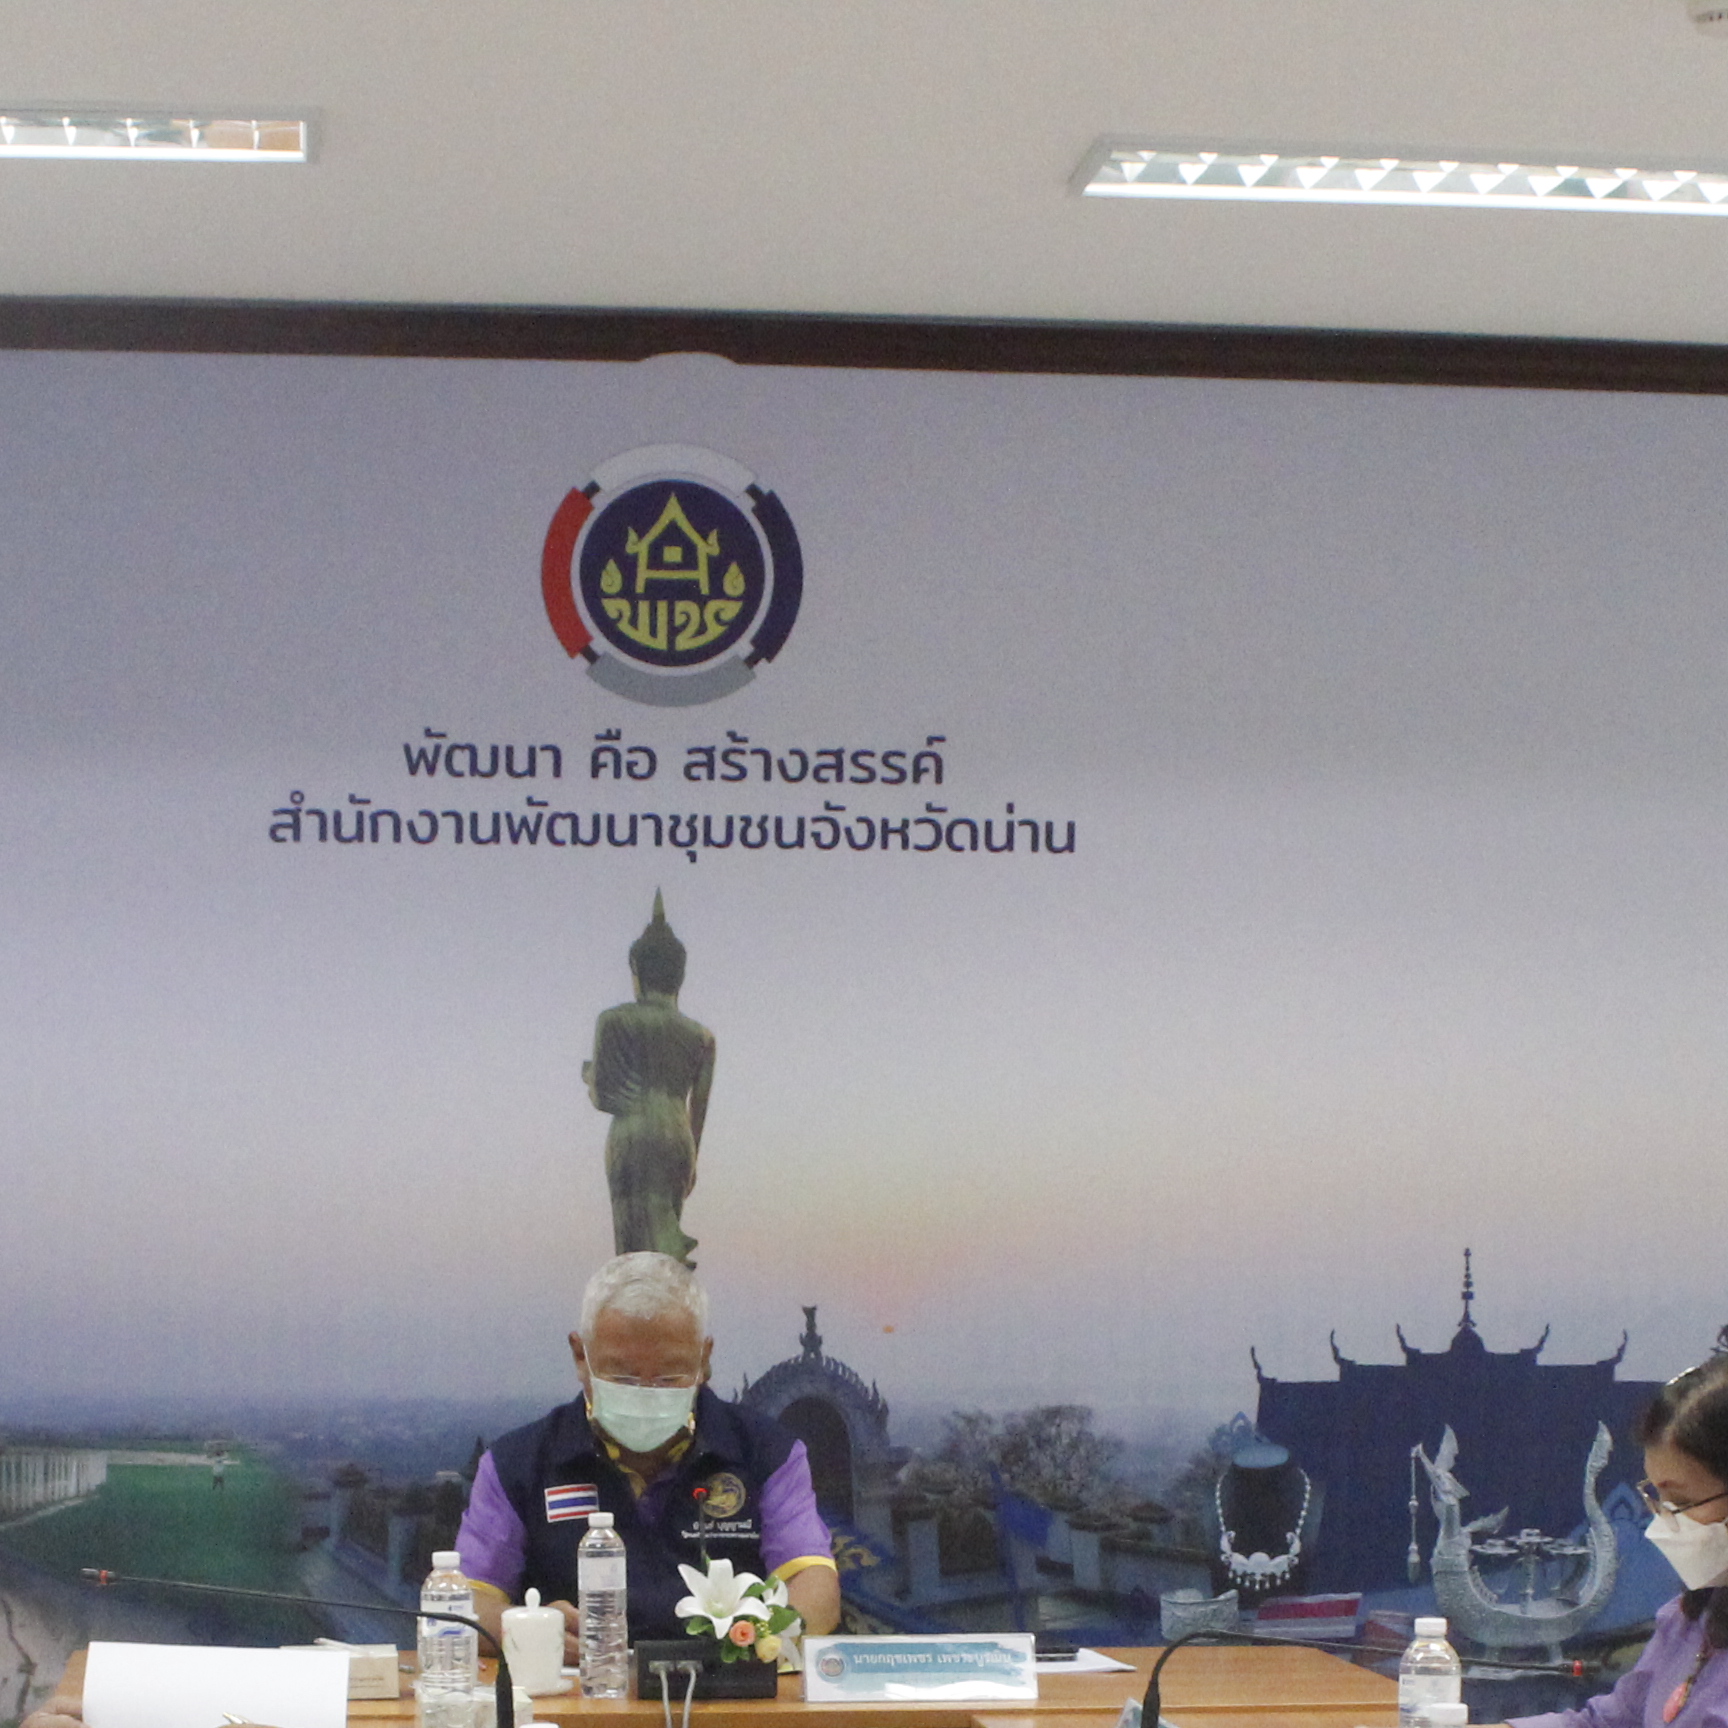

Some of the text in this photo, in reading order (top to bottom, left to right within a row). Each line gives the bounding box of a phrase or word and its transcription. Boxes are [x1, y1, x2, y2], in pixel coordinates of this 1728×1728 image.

[403, 728, 946, 786] พัฒนา คือ สร้างสรรค์
[267, 791, 1078, 864] สำนักงานพัฒนาชุมชนจังหวัดน่าน
